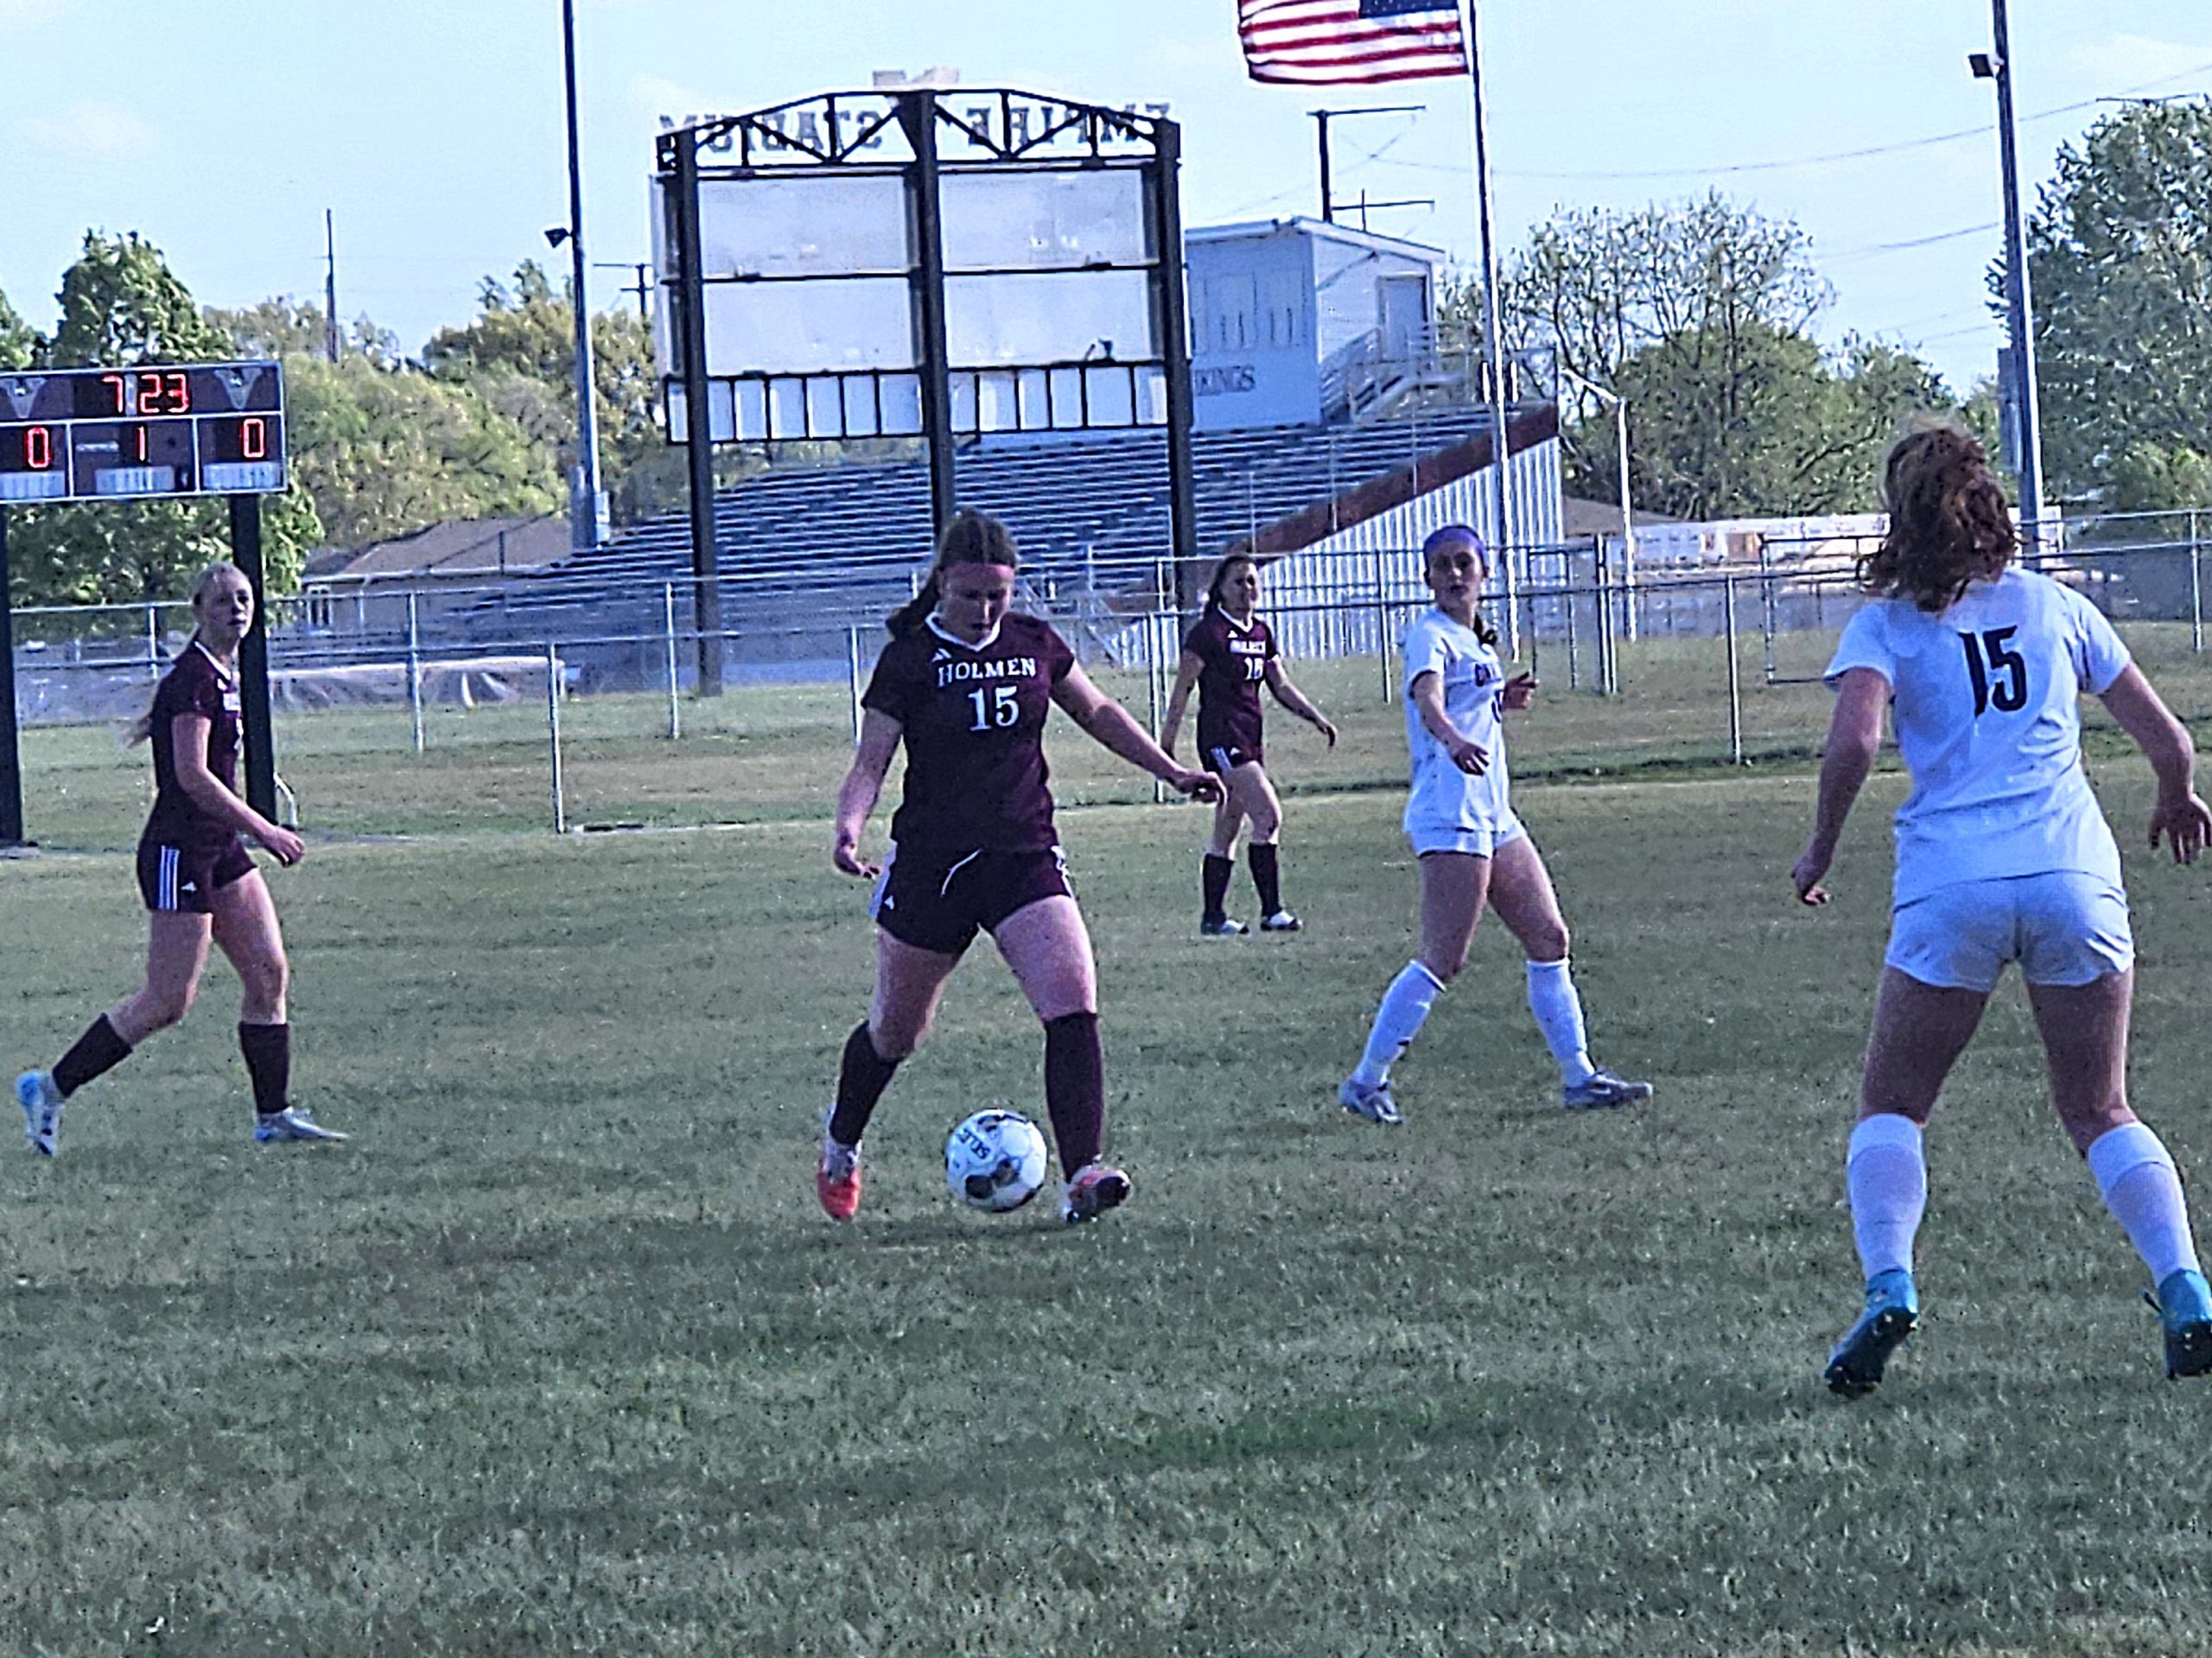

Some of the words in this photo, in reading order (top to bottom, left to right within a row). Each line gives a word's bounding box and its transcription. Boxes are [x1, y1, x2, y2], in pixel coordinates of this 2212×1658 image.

[25, 426, 52, 469] 0
[136, 425, 147, 462] 1
[241, 417, 265, 459] 0
[938, 657, 1036, 688] HOLMEN
[1957, 624, 2028, 719] 15
[968, 685, 1020, 731] 15
